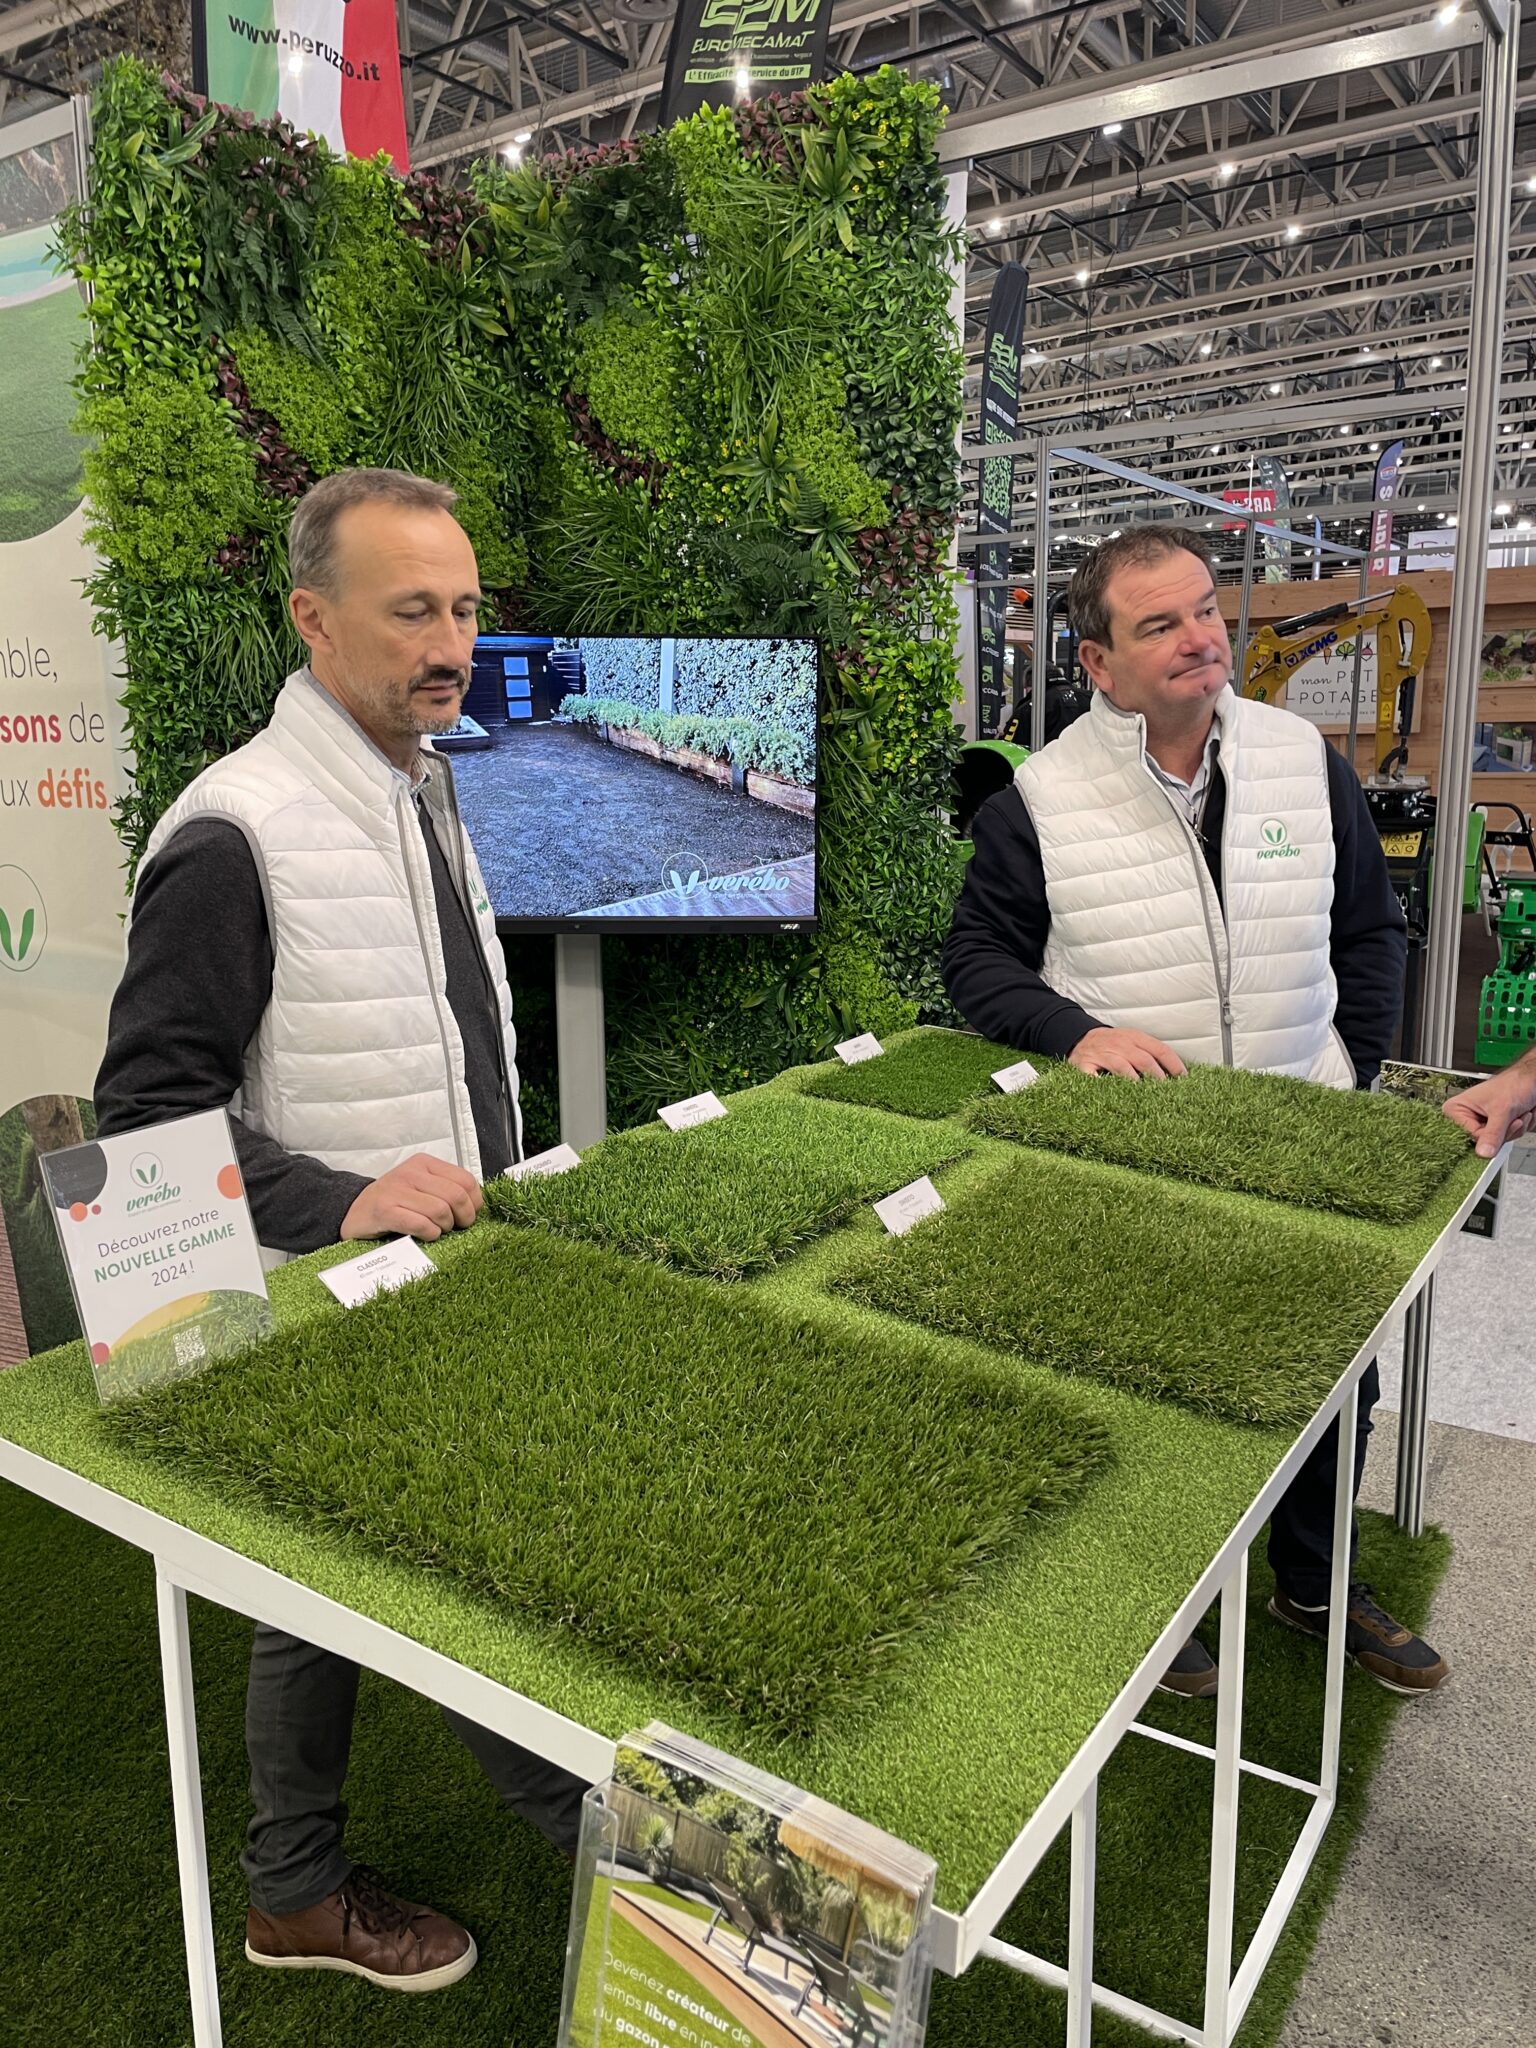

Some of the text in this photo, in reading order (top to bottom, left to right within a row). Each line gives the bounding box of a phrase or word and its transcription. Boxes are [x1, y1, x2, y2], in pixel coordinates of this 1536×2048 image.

[228, 14, 380, 81] www.peruzzo.it
[691, 30, 816, 54] EUROMECAMAT
[751, 67, 778, 78] ervice
[1299, 631, 1338, 660] XCMG
[69, 701, 105, 743] de
[1257, 843, 1301, 861] verébo
[708, 867, 790, 892] verébo
[126, 1182, 181, 1212] verébo
[97, 1219, 180, 1259] Découvrez
[181, 1208, 220, 1231] notre
[93, 1223, 237, 1284] NOUVELLE GAMME
[356, 1255, 389, 1273] CLASSICO
[150, 1267, 188, 1288] 2024
[603, 1982, 642, 2012] emps
[643, 2000, 678, 2033] libre
[679, 2024, 698, 2045] en
[666, 1988, 730, 2034] créateur
[730, 2027, 752, 2047] de
[615, 2016, 660, 2048] gazon
